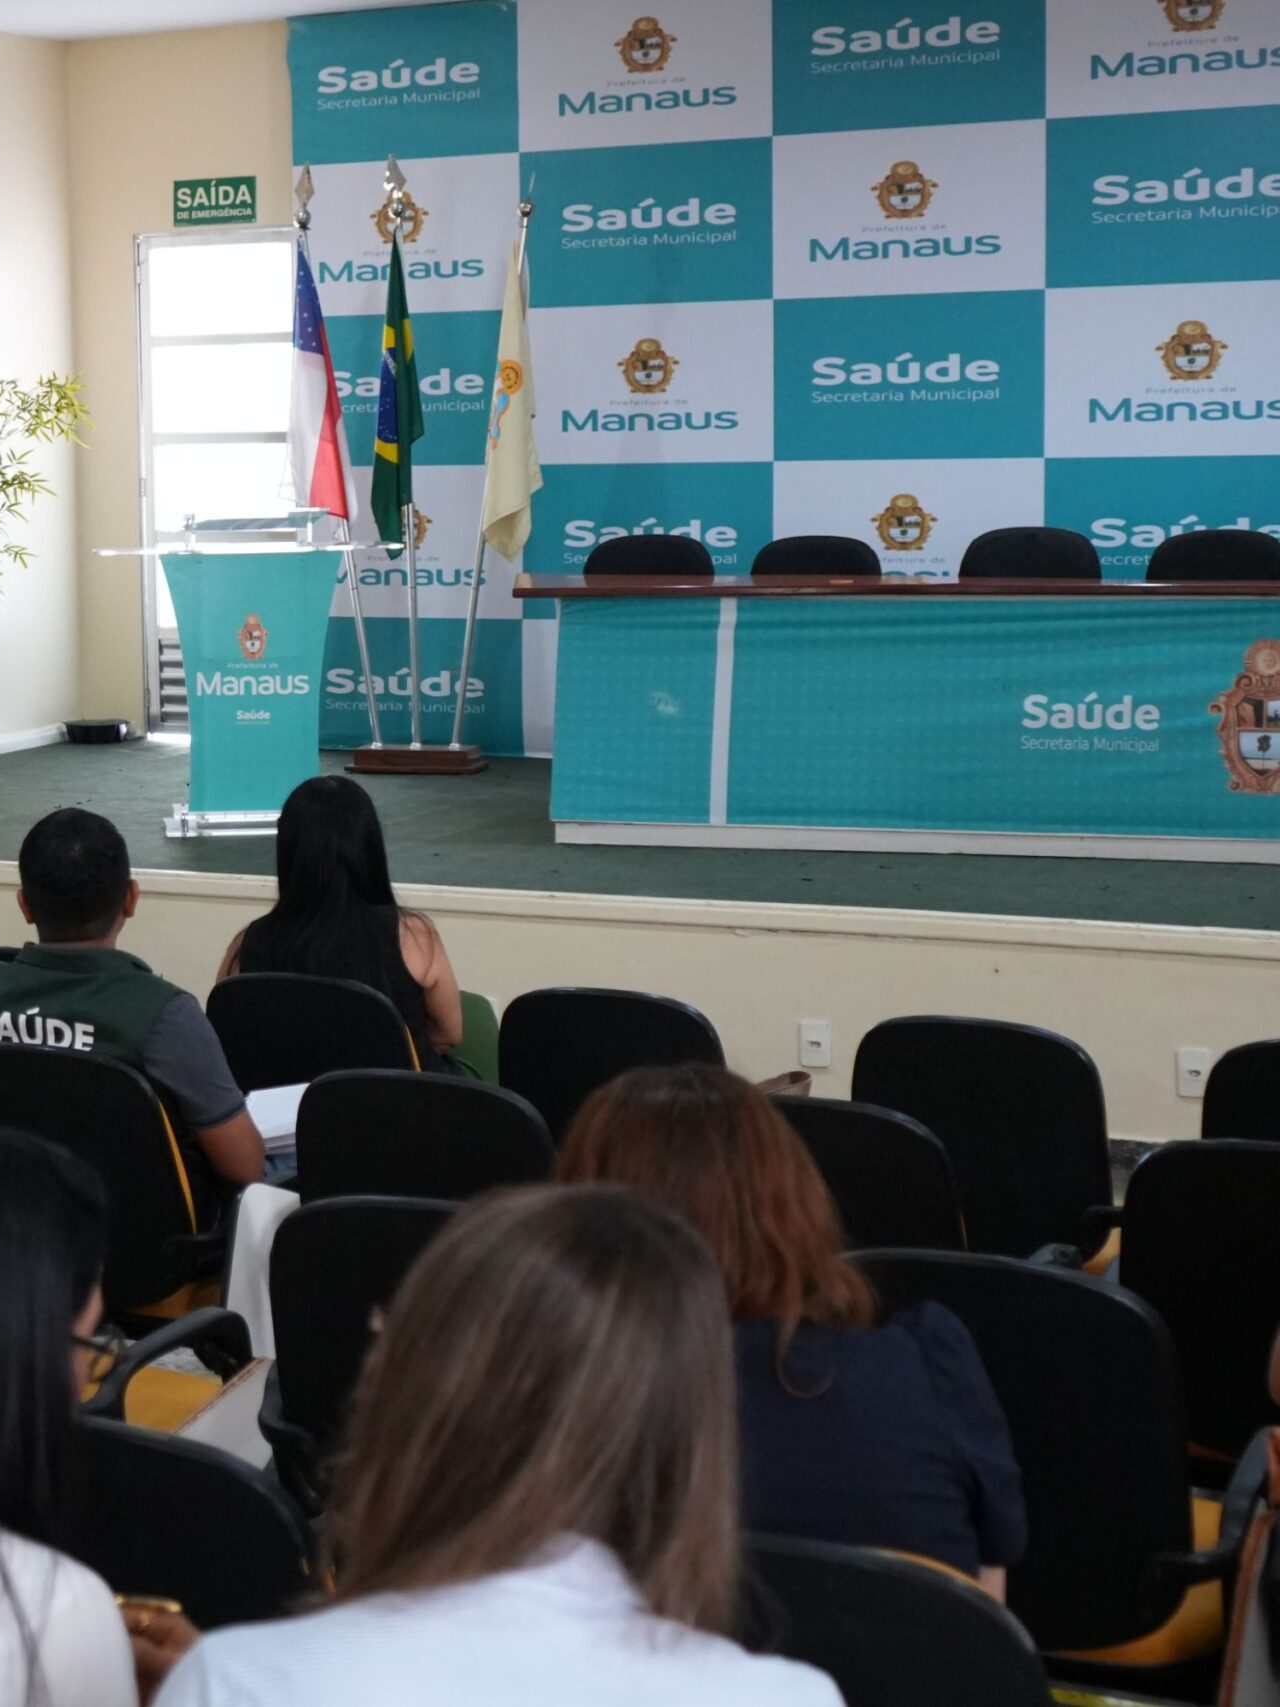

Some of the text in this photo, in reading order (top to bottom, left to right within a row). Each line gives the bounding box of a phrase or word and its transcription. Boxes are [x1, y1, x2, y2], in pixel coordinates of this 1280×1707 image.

[810, 16, 1000, 56] Saúde
[1148, 35, 1239, 48] Prefeitura de
[810, 48, 1000, 74] Secretaria Municipal
[317, 58, 480, 94] Saúde
[606, 76, 687, 88] Prefeitura de
[317, 88, 480, 110] Secretaria Municipal
[558, 85, 737, 117] Manaus
[177, 180, 252, 208] SAÍDA
[1092, 168, 1280, 205] Saúde
[177, 207, 252, 219] DE EMERGÊNCIA
[562, 197, 736, 233] Saúde
[1092, 204, 1280, 224] Secretaria Municip
[562, 230, 736, 250] Secretaria Municipal
[862, 224, 927, 233] Prefeitura
[810, 233, 1001, 262] Manaus
[812, 351, 1000, 386] Saúde
[334, 368, 484, 398] Sade
[1145, 385, 1237, 395] Prefeitura de
[422, 400, 484, 412] unicipal
[812, 387, 1000, 404] Secretaria Municipal
[561, 408, 738, 432] Manaus
[196, 671, 310, 696] Manaus
[326, 667, 484, 697] Saúde
[236, 710, 271, 720] Saúde
[326, 698, 485, 714] Secrearia unicpal
[1022, 692, 1160, 730] Saúde
[1021, 735, 1159, 753] Secretaria Municipal
